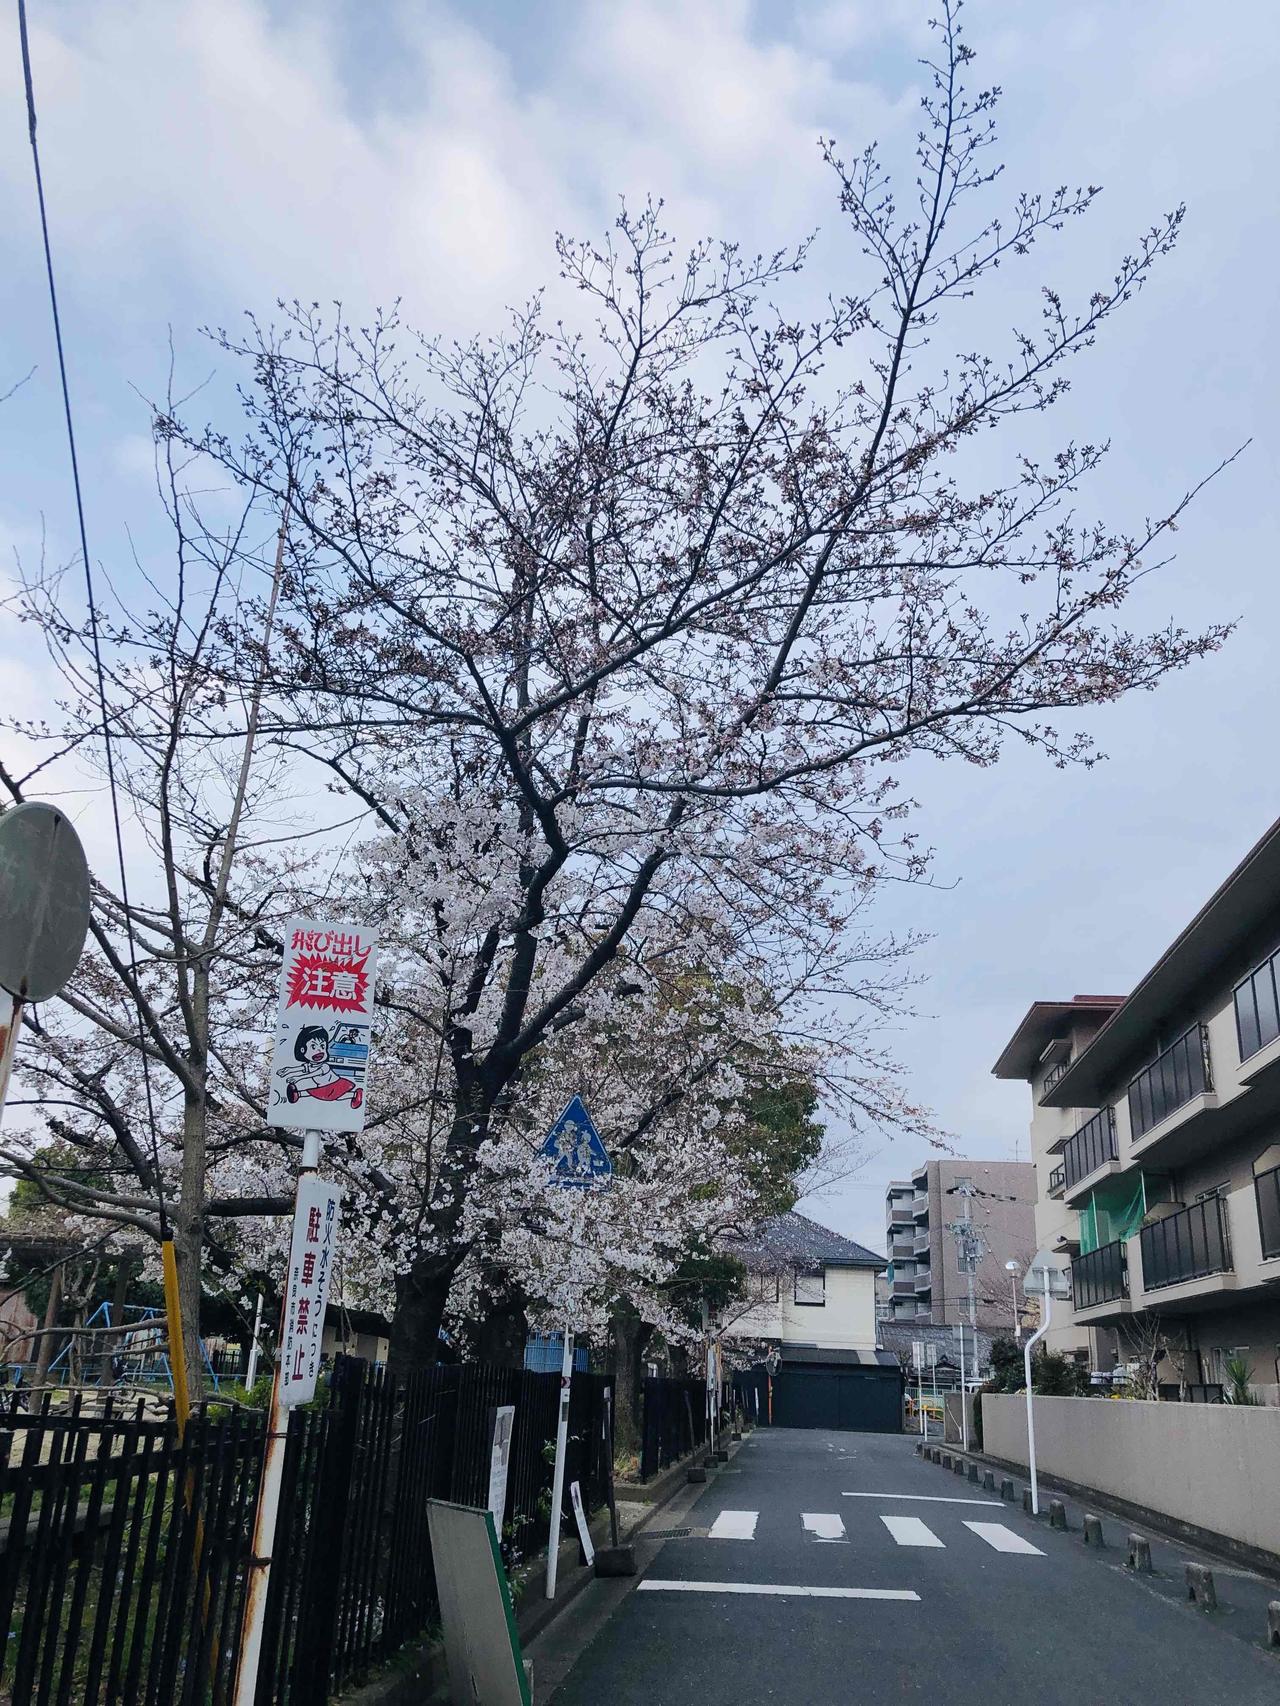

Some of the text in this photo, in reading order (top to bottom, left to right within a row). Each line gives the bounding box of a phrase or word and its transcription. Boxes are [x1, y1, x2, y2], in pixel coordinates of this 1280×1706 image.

[290, 928, 373, 958] 飛び出し
[300, 968, 359, 1000] 注意
[291, 1206, 322, 1381] 駐車禁止
[308, 1198, 336, 1378] 防火水そうにつき
